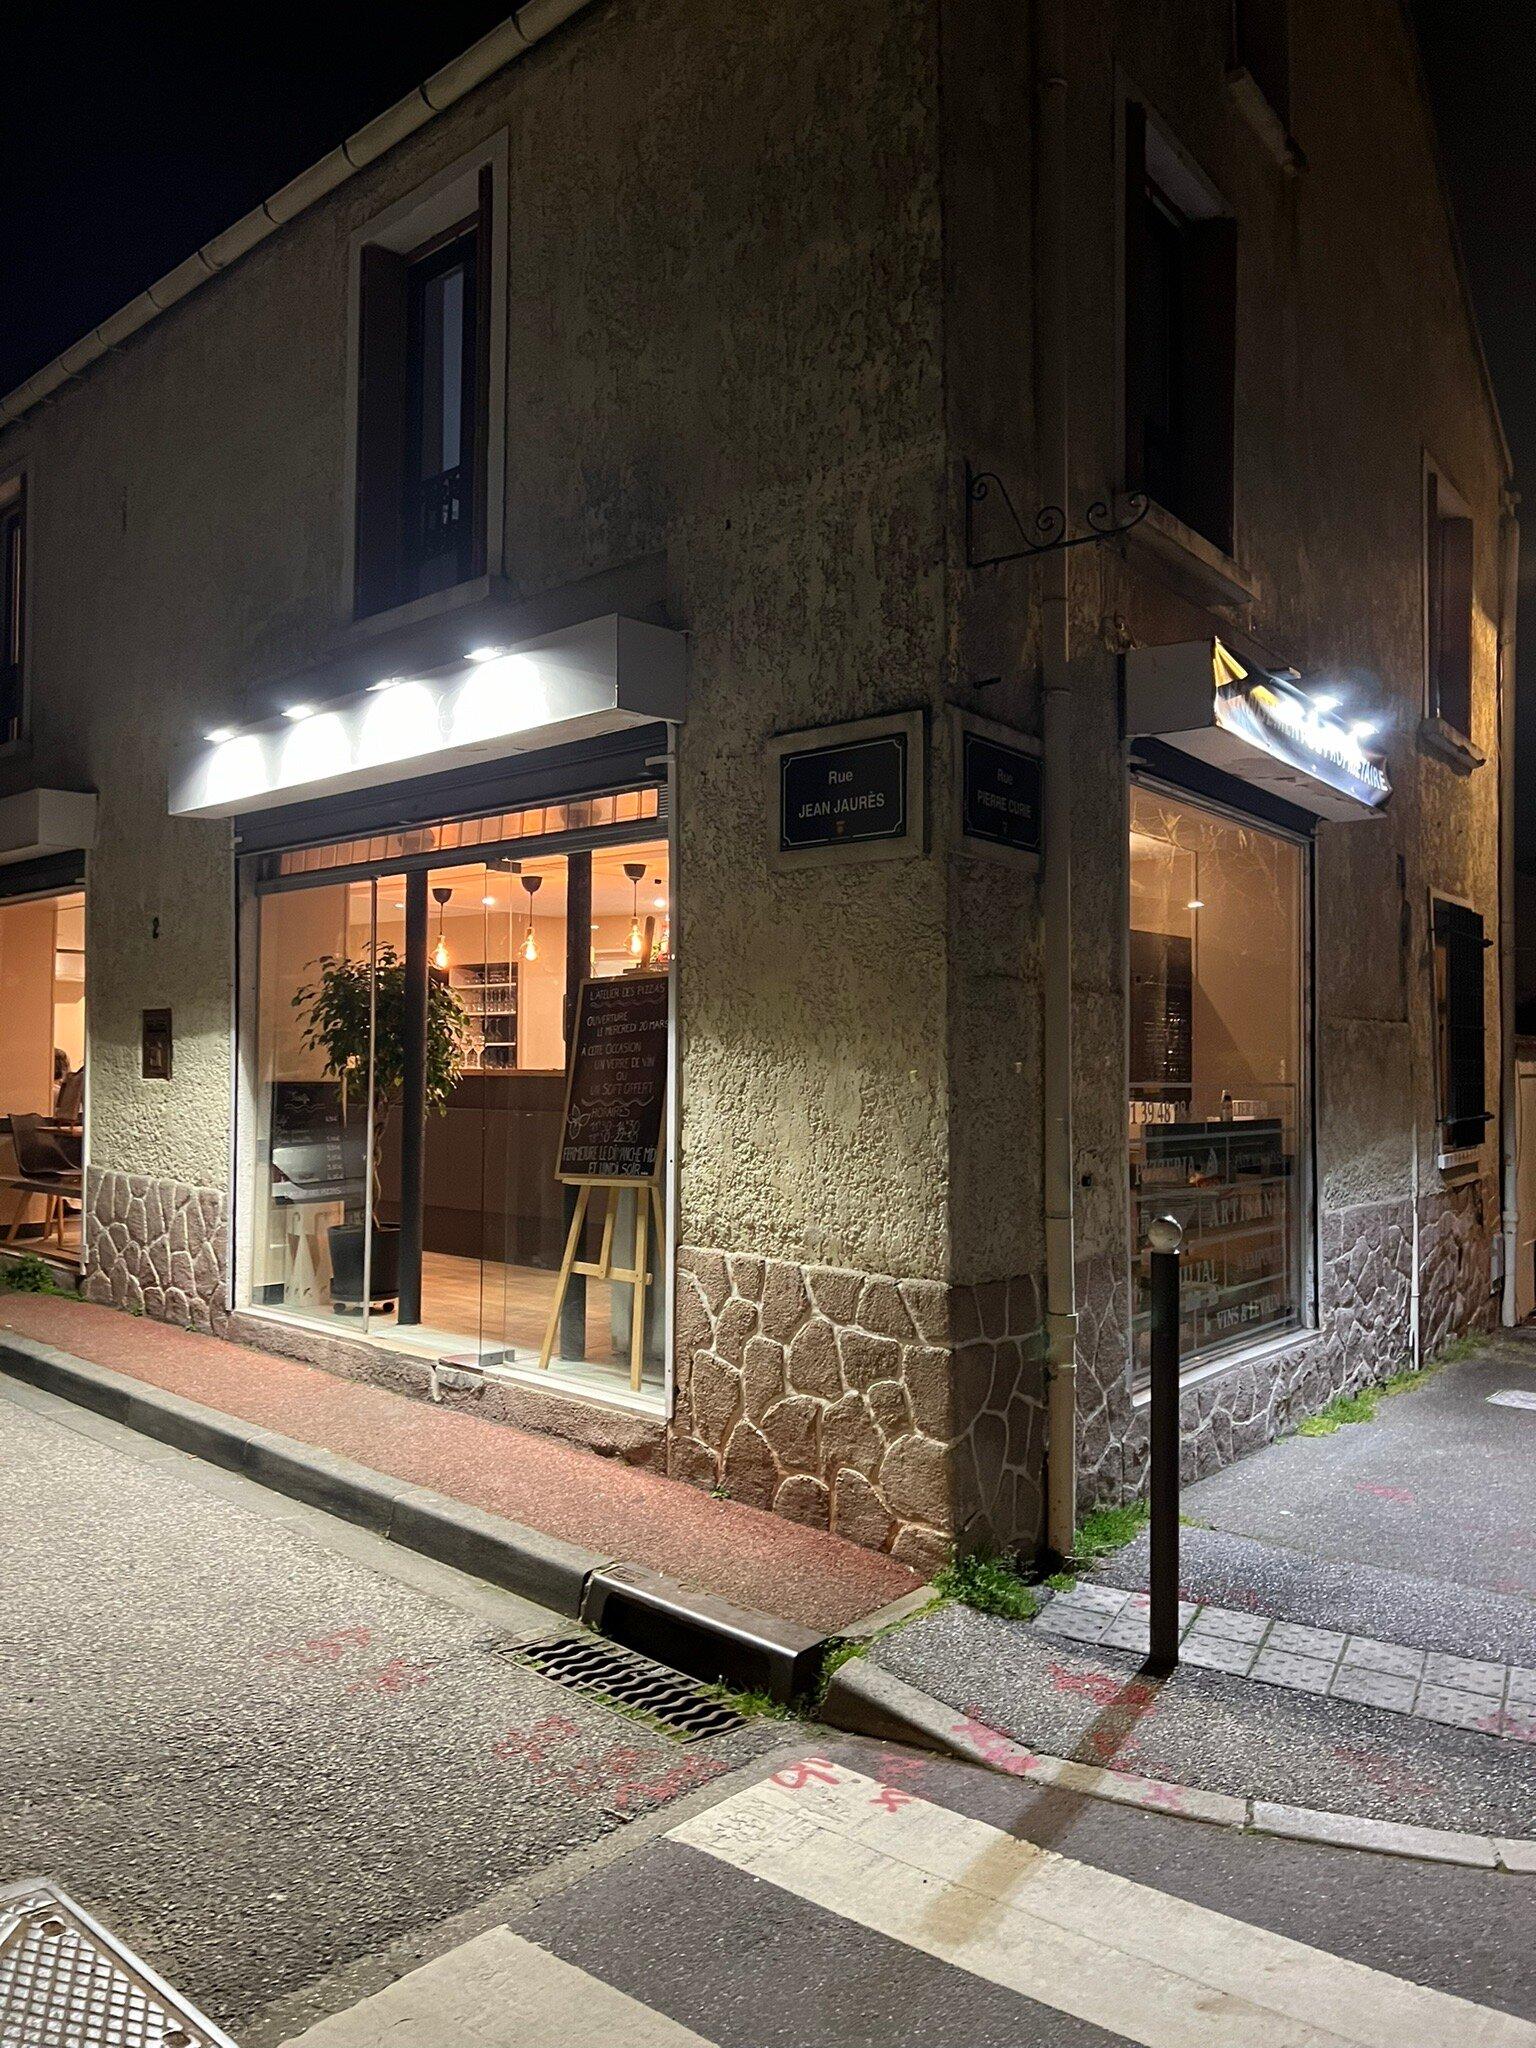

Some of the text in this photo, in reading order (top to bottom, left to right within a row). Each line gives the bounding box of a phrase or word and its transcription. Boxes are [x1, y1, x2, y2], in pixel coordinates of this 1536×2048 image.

[828, 769, 854, 785] Rue
[997, 768, 1014, 785] Rue
[798, 791, 885, 819] JEAN JAURÈS
[977, 789, 1008, 811] PIERRE
[622, 986, 634, 998] DES
[637, 983, 666, 995] PIZZAS
[586, 1011, 628, 1027] OUVERTURE
[596, 1018, 668, 1037] LE MERCREDI 20 MARS
[605, 1041, 642, 1055] OCCASION
[630, 1056, 640, 1068] DE
[641, 1055, 656, 1067] VIN
[616, 1071, 628, 1081] OU
[601, 1082, 623, 1096] SOFT
[1141, 1101, 1155, 1124] 39
[1157, 1100, 1171, 1123] 48
[598, 1145, 607, 1161] LE
[607, 1144, 643, 1162] DIMANCHE
[588, 1162, 597, 1175] ET
